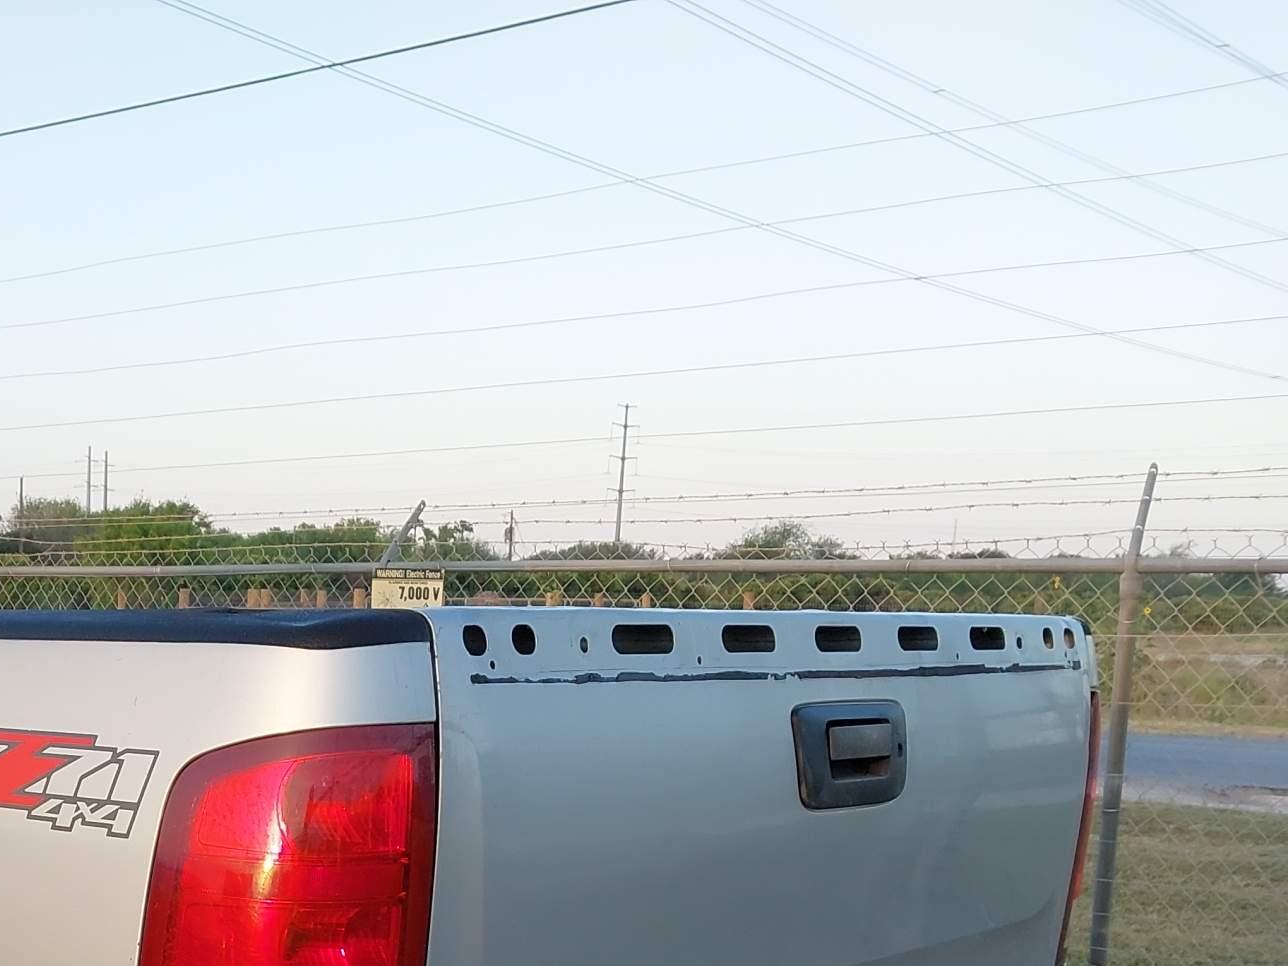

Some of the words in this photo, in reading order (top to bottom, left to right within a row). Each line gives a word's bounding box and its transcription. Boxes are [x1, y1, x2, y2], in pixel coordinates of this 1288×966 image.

[376, 569, 405, 578] WARNING!
[406, 569, 424, 578] Electric
[425, 570, 441, 579] Fence
[398, 586, 430, 602] 7,000
[433, 586, 440, 600] V
